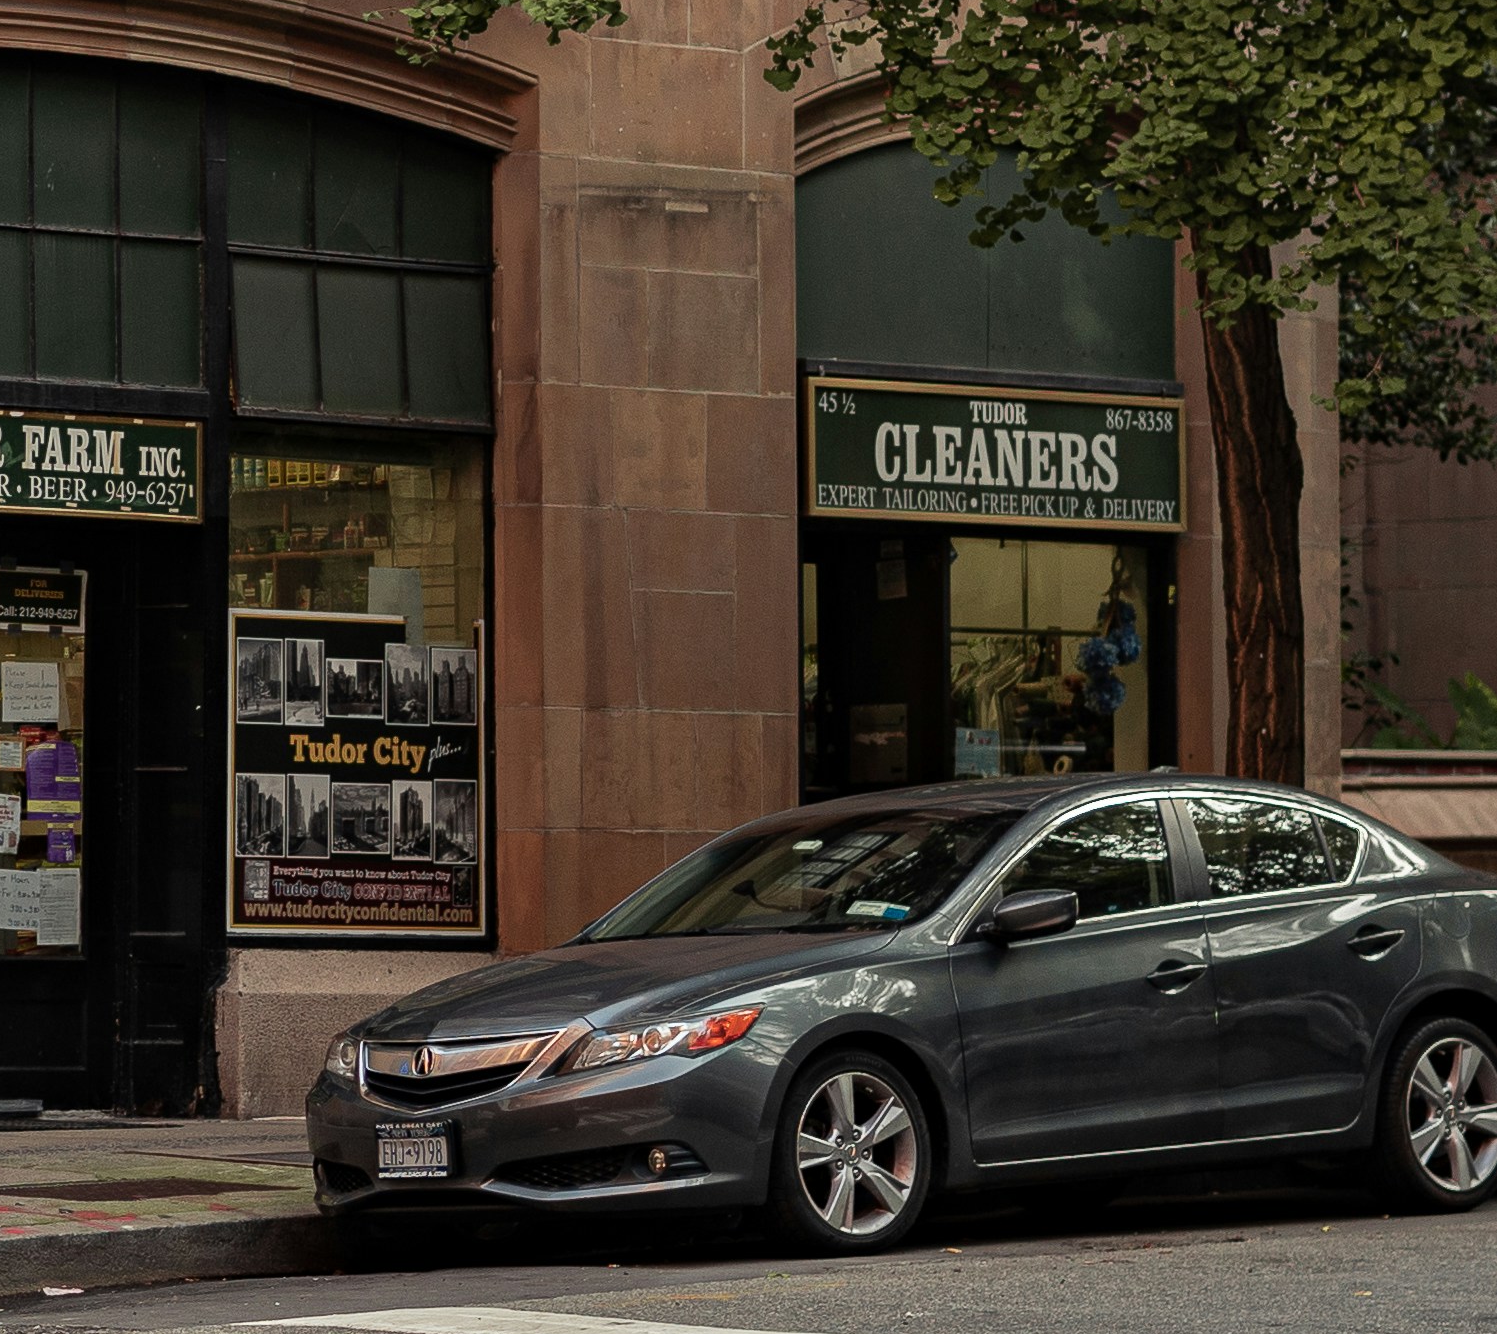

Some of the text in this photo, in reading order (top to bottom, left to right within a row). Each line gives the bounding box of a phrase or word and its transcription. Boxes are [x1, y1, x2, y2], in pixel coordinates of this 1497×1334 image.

[818, 392, 838, 413] 45
[969, 401, 1028, 424] TUDOR
[1105, 408, 1174, 432] 867-8358
[21, 424, 125, 475] FARM
[138, 446, 186, 478] INC.
[874, 421, 1119, 493] CLEANERS
[29, 475, 89, 502] BEER
[105, 480, 186, 506] 949-6257
[818, 484, 1176, 522] EXPERT TAILORING FREE PICK UP & DELIVERY
[14, 588, 64, 599] DELIVERIES
[30, 578, 48, 588] FOR
[19, 607, 78, 620] 212-949-6257
[289, 734, 463, 774] Tudor City plus...
[273, 865, 451, 883] Everything you want to know about Tudor City
[272, 879, 451, 902] Tudor City CONFIDENTIAL
[244, 900, 473, 924] www.tudorcityconfidential.com
[382, 1138, 443, 1166] EHJ 9198
